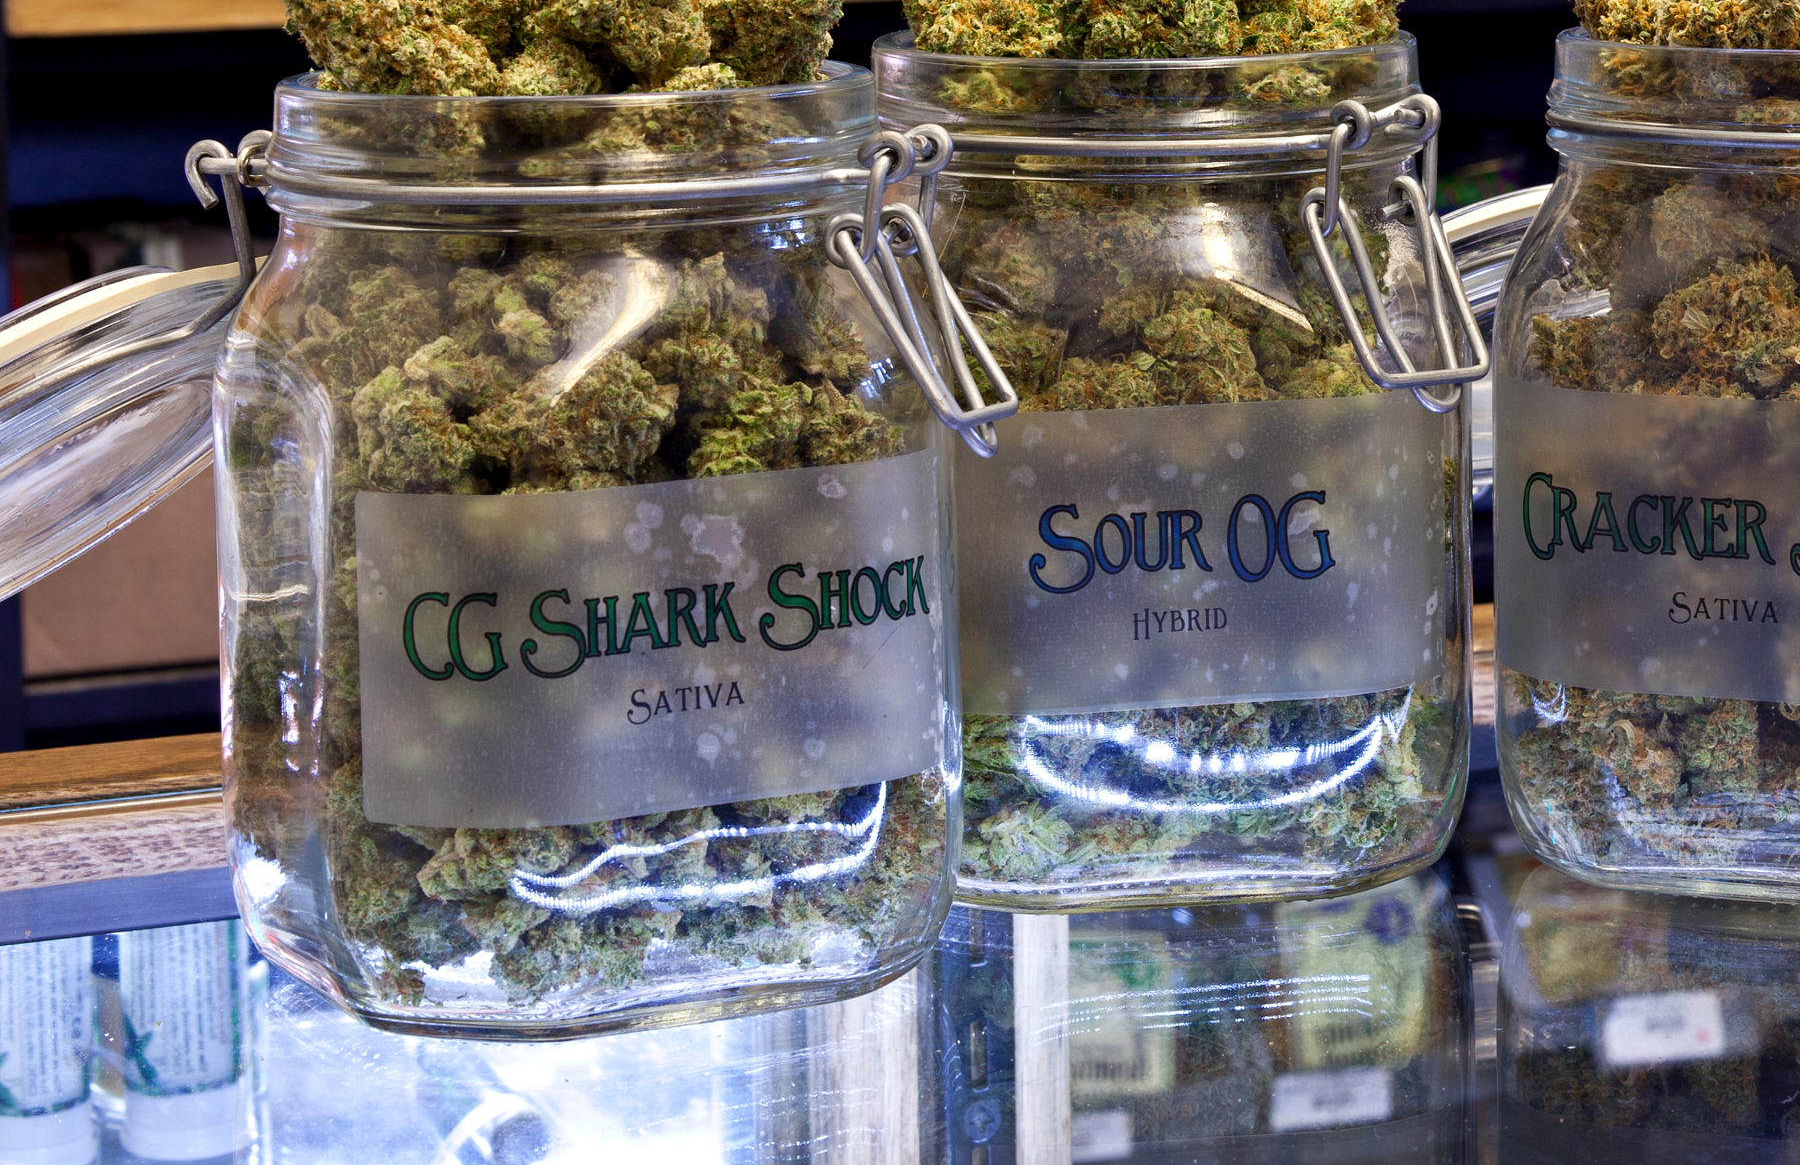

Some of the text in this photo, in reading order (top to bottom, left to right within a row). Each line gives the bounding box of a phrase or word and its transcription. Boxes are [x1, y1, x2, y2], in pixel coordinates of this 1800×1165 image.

[1028, 490, 1336, 595] SOUR OG
[1522, 471, 1777, 566] CRACKER
[403, 555, 931, 682] CG SHARK SHOCK
[1132, 606, 1229, 642] HYBRID
[1667, 591, 1780, 625] SATIVA
[626, 681, 746, 725] SATIVA
